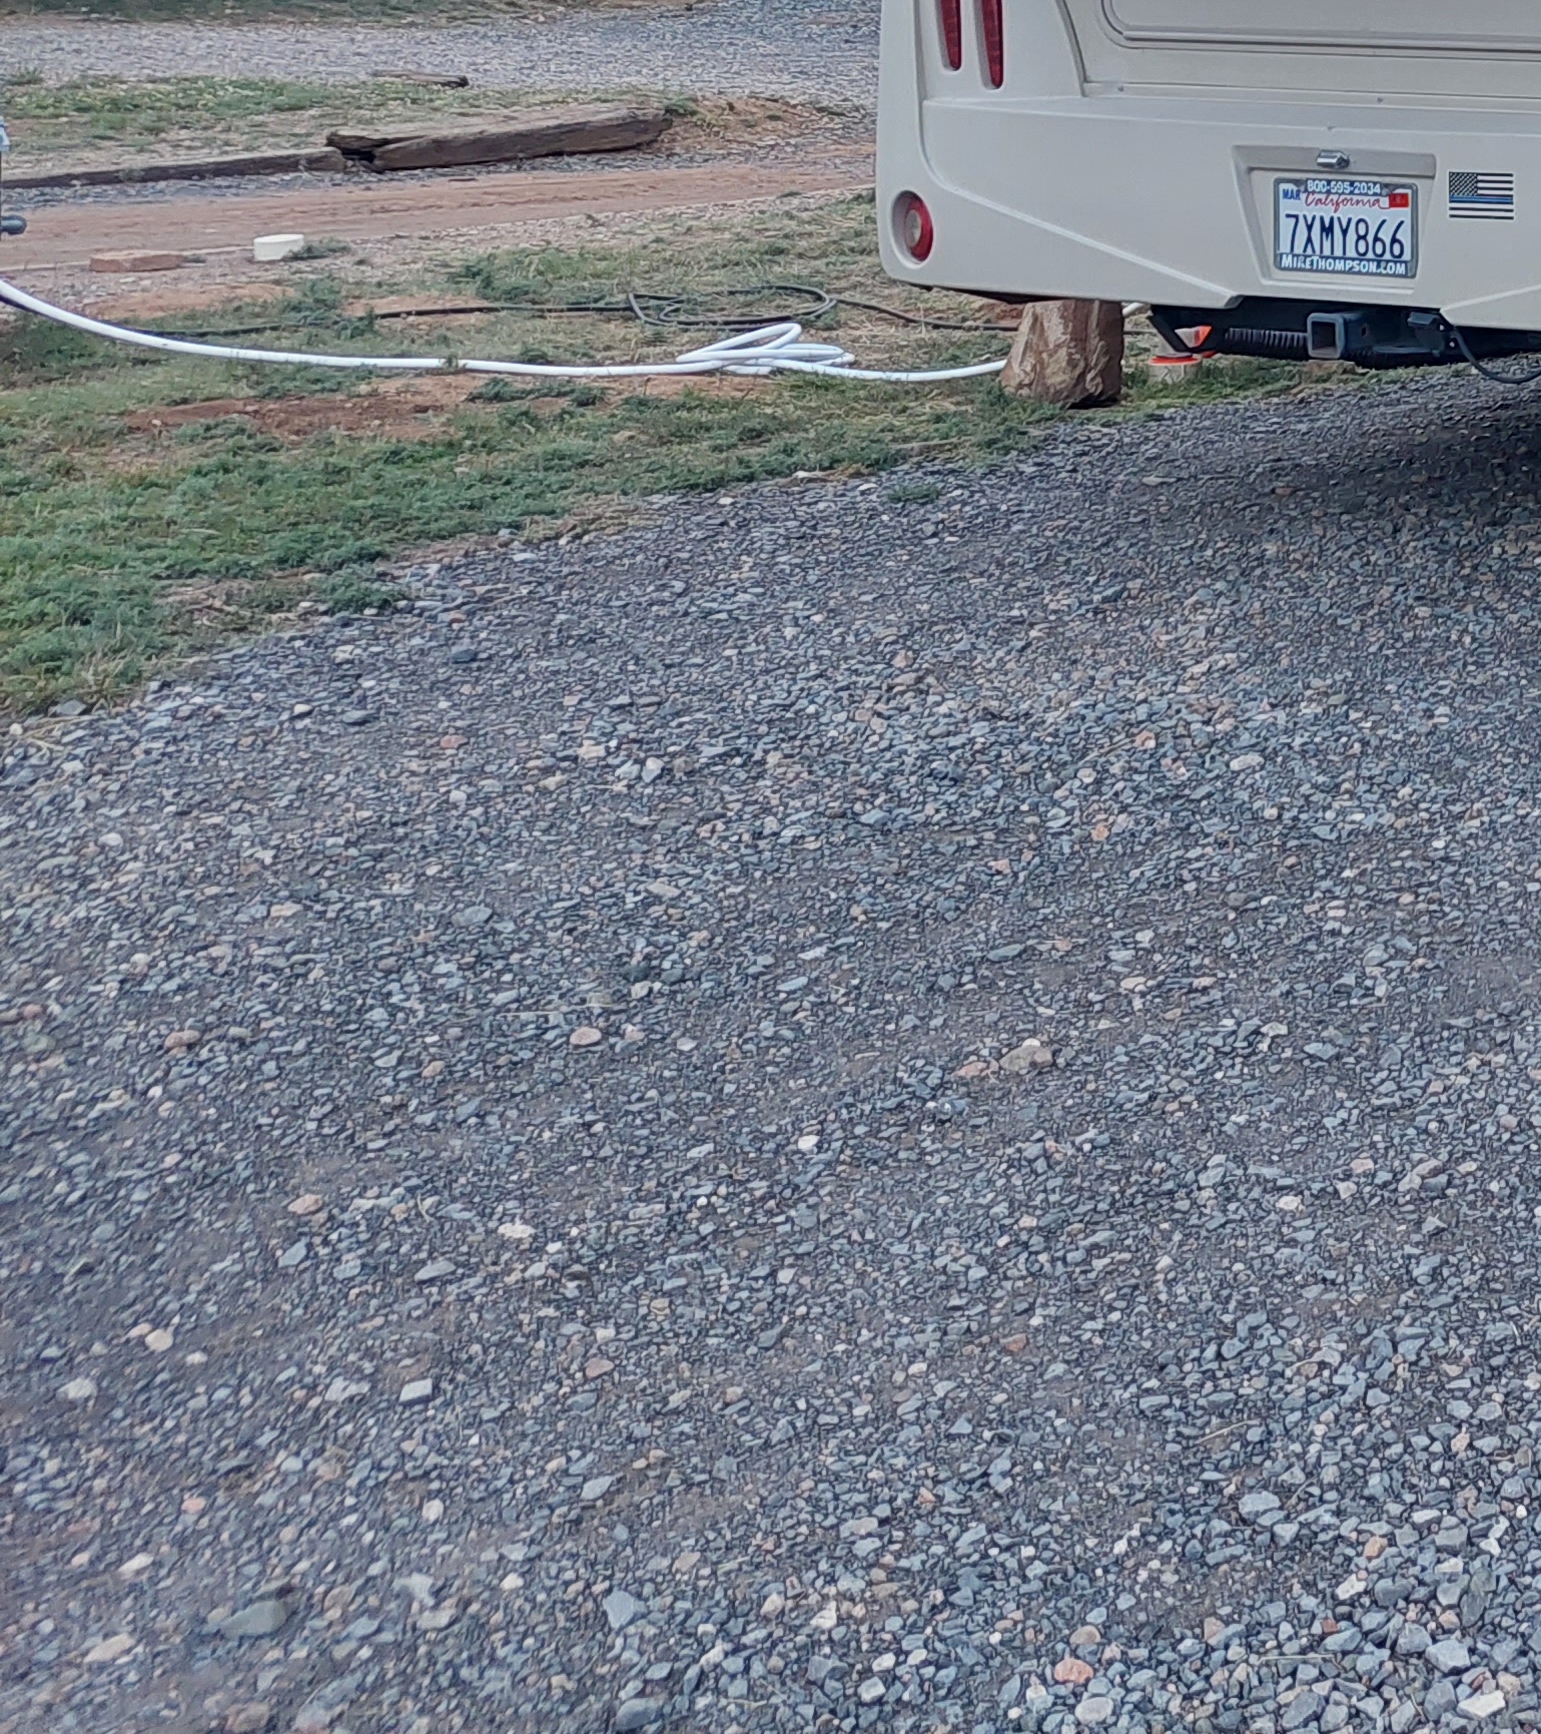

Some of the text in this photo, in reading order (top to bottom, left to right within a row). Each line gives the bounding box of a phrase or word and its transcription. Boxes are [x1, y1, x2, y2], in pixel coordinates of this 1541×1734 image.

[1306, 179, 1382, 195] 800-595-2034
[1304, 191, 1390, 214] California
[1285, 213, 1405, 259] 7XMY866
